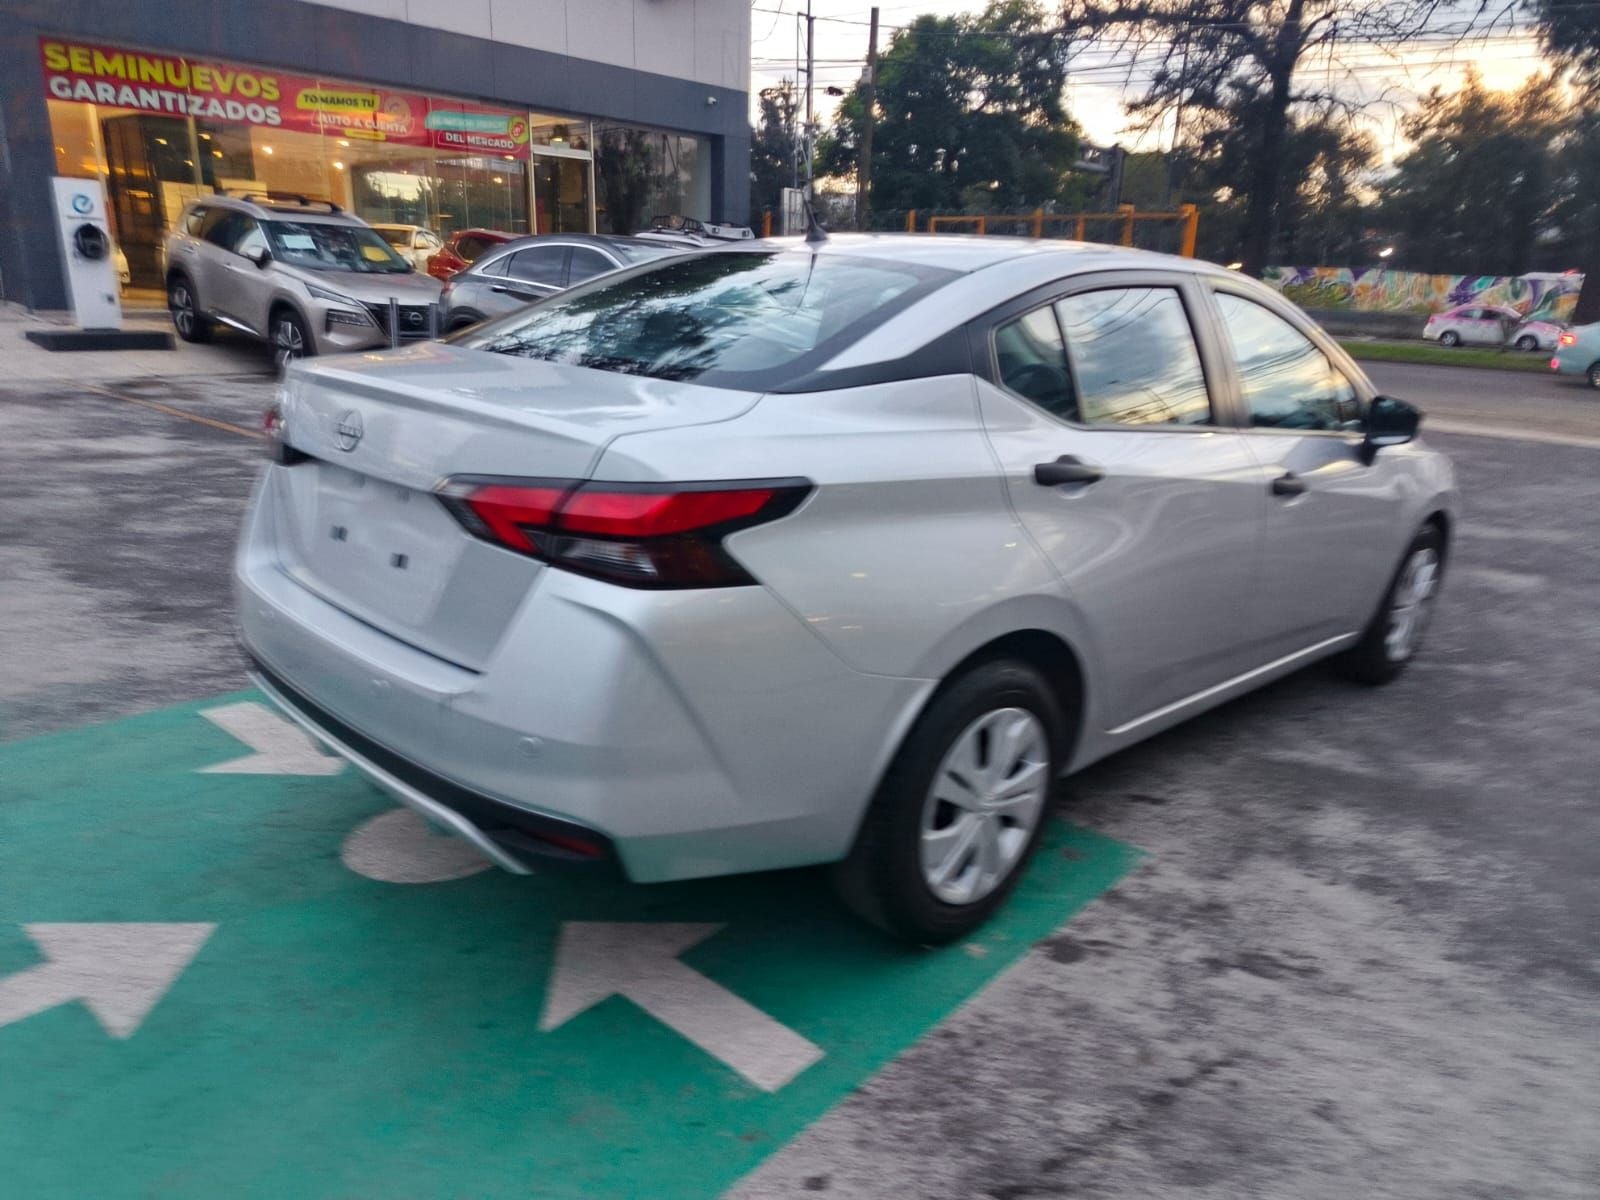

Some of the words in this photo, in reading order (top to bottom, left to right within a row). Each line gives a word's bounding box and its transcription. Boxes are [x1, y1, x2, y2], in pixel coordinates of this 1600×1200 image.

[43, 43, 281, 100] SEMINUEVOS
[50, 76, 282, 125] GARANTIZADOS
[303, 94, 359, 107] TOMAMOS
[362, 98, 375, 108] TU
[445, 132, 465, 143] DEL
[467, 135, 515, 149] MERCADO
